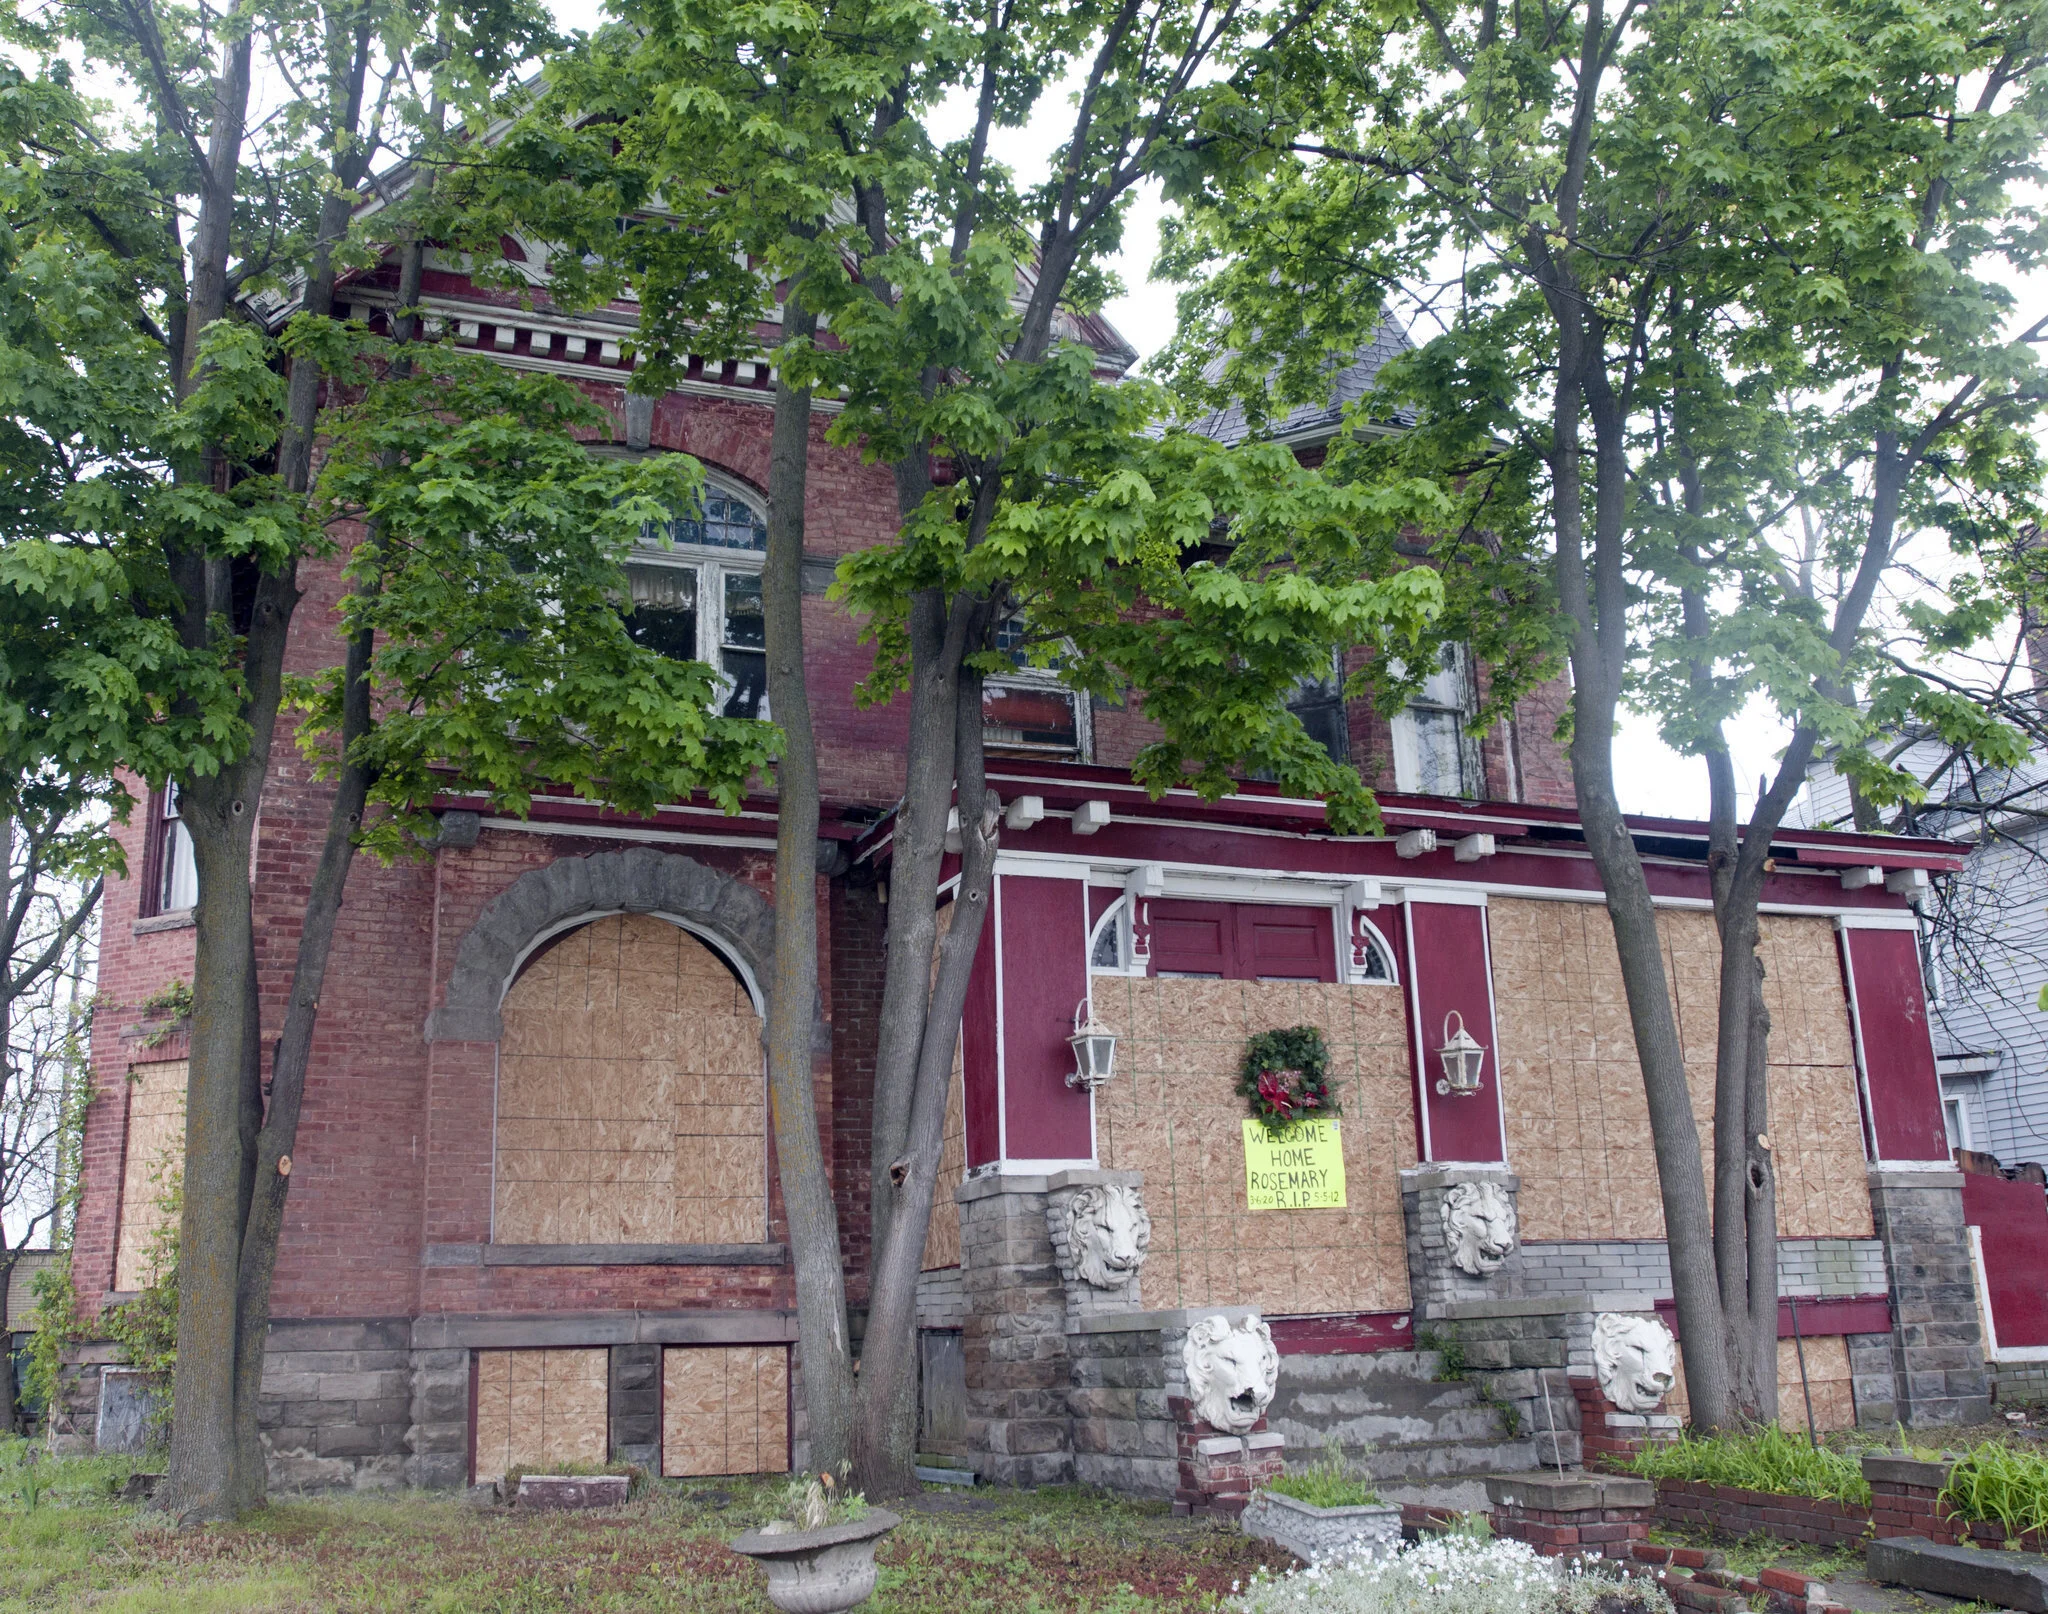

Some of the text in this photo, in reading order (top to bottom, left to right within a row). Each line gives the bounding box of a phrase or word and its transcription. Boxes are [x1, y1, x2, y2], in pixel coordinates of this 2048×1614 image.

[1249, 1125, 1328, 1144] WELCOME
[1271, 1148, 1315, 1167] HOME
[1251, 1169, 1328, 1190] ROSEMARY
[1276, 1190, 1311, 1208] R.I.P.
